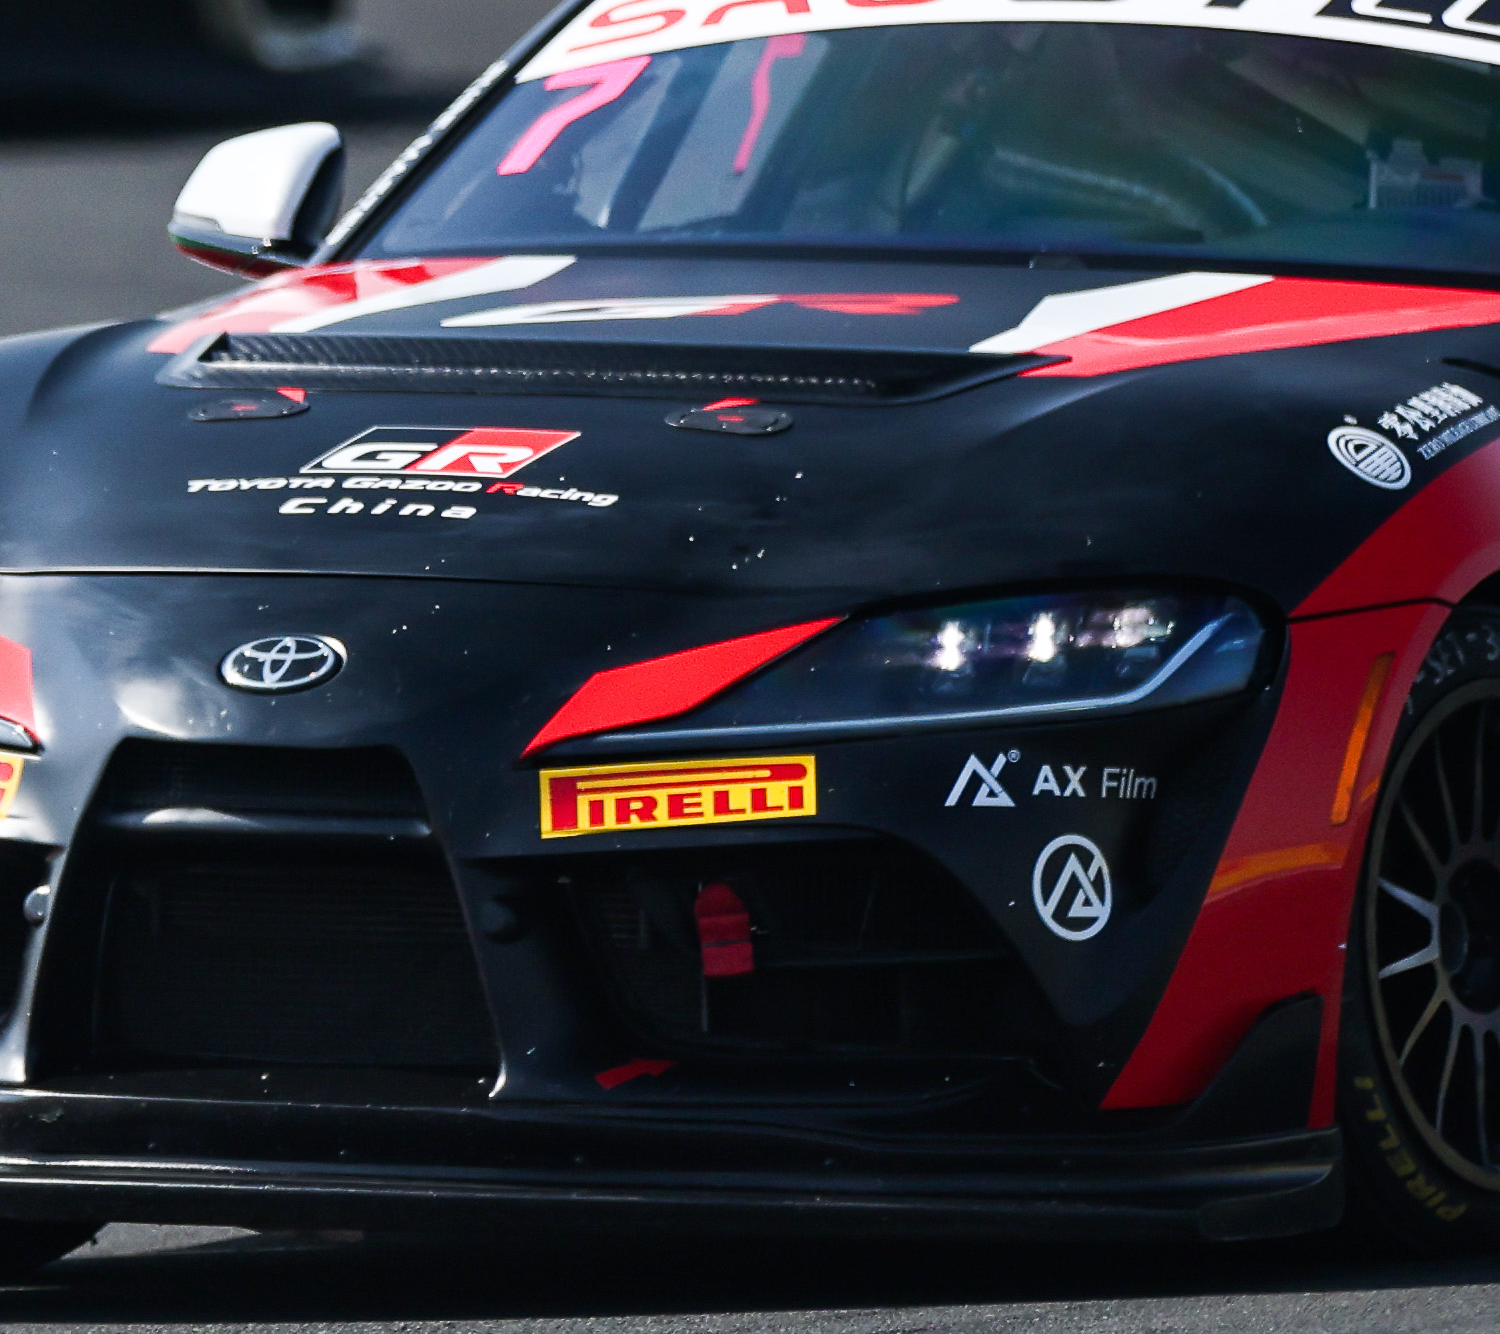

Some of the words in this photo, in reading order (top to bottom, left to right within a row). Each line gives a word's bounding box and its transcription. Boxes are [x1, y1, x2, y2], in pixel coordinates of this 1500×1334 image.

[498, 54, 652, 176] 7
[321, 441, 535, 474] GR
[187, 477, 335, 494] TOYOTA
[341, 476, 483, 494] GAZOO
[485, 481, 620, 508] Racing
[278, 496, 478, 520] China
[550, 763, 808, 832] PIRELLI
[1032, 764, 1087, 798] AX
[1101, 767, 1157, 800] Film
[1353, 1074, 1468, 1223] PIRELLI
